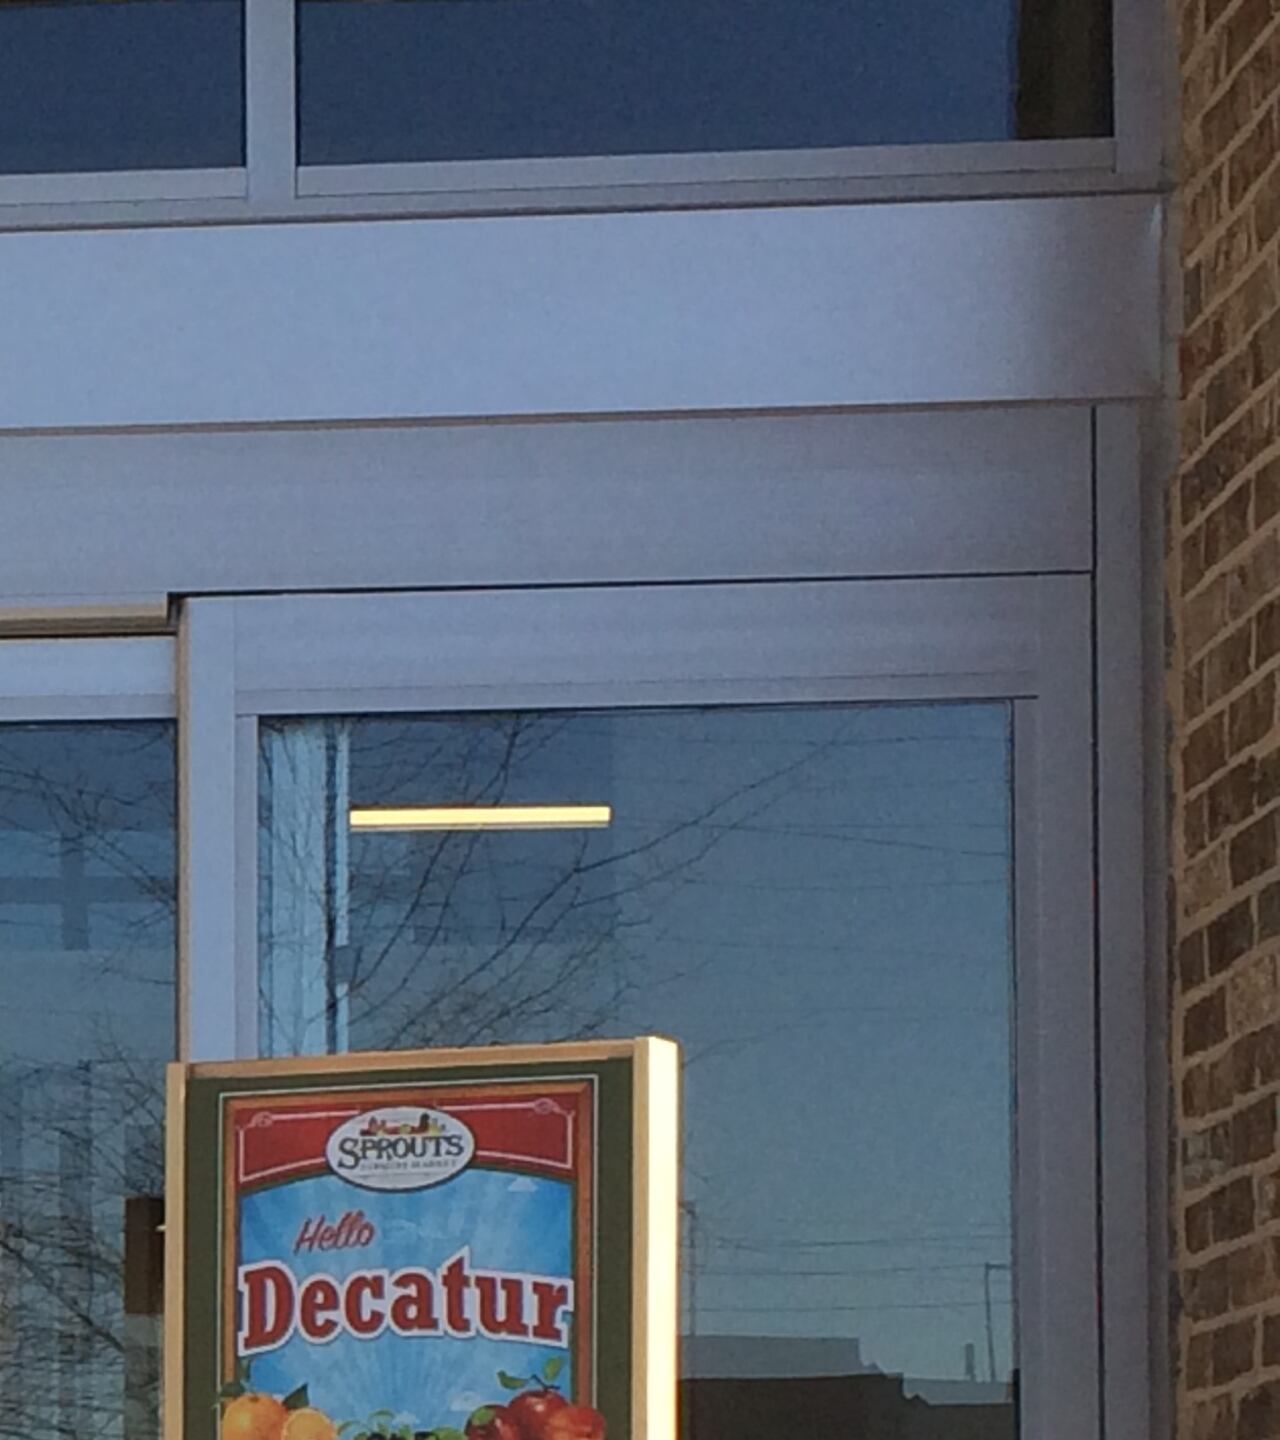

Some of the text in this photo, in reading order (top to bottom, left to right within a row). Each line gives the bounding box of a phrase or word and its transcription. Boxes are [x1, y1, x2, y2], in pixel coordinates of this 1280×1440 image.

[338, 1135, 465, 1169] SPROUTS
[294, 1211, 375, 1253] Hello
[242, 1252, 571, 1353] Decatur
